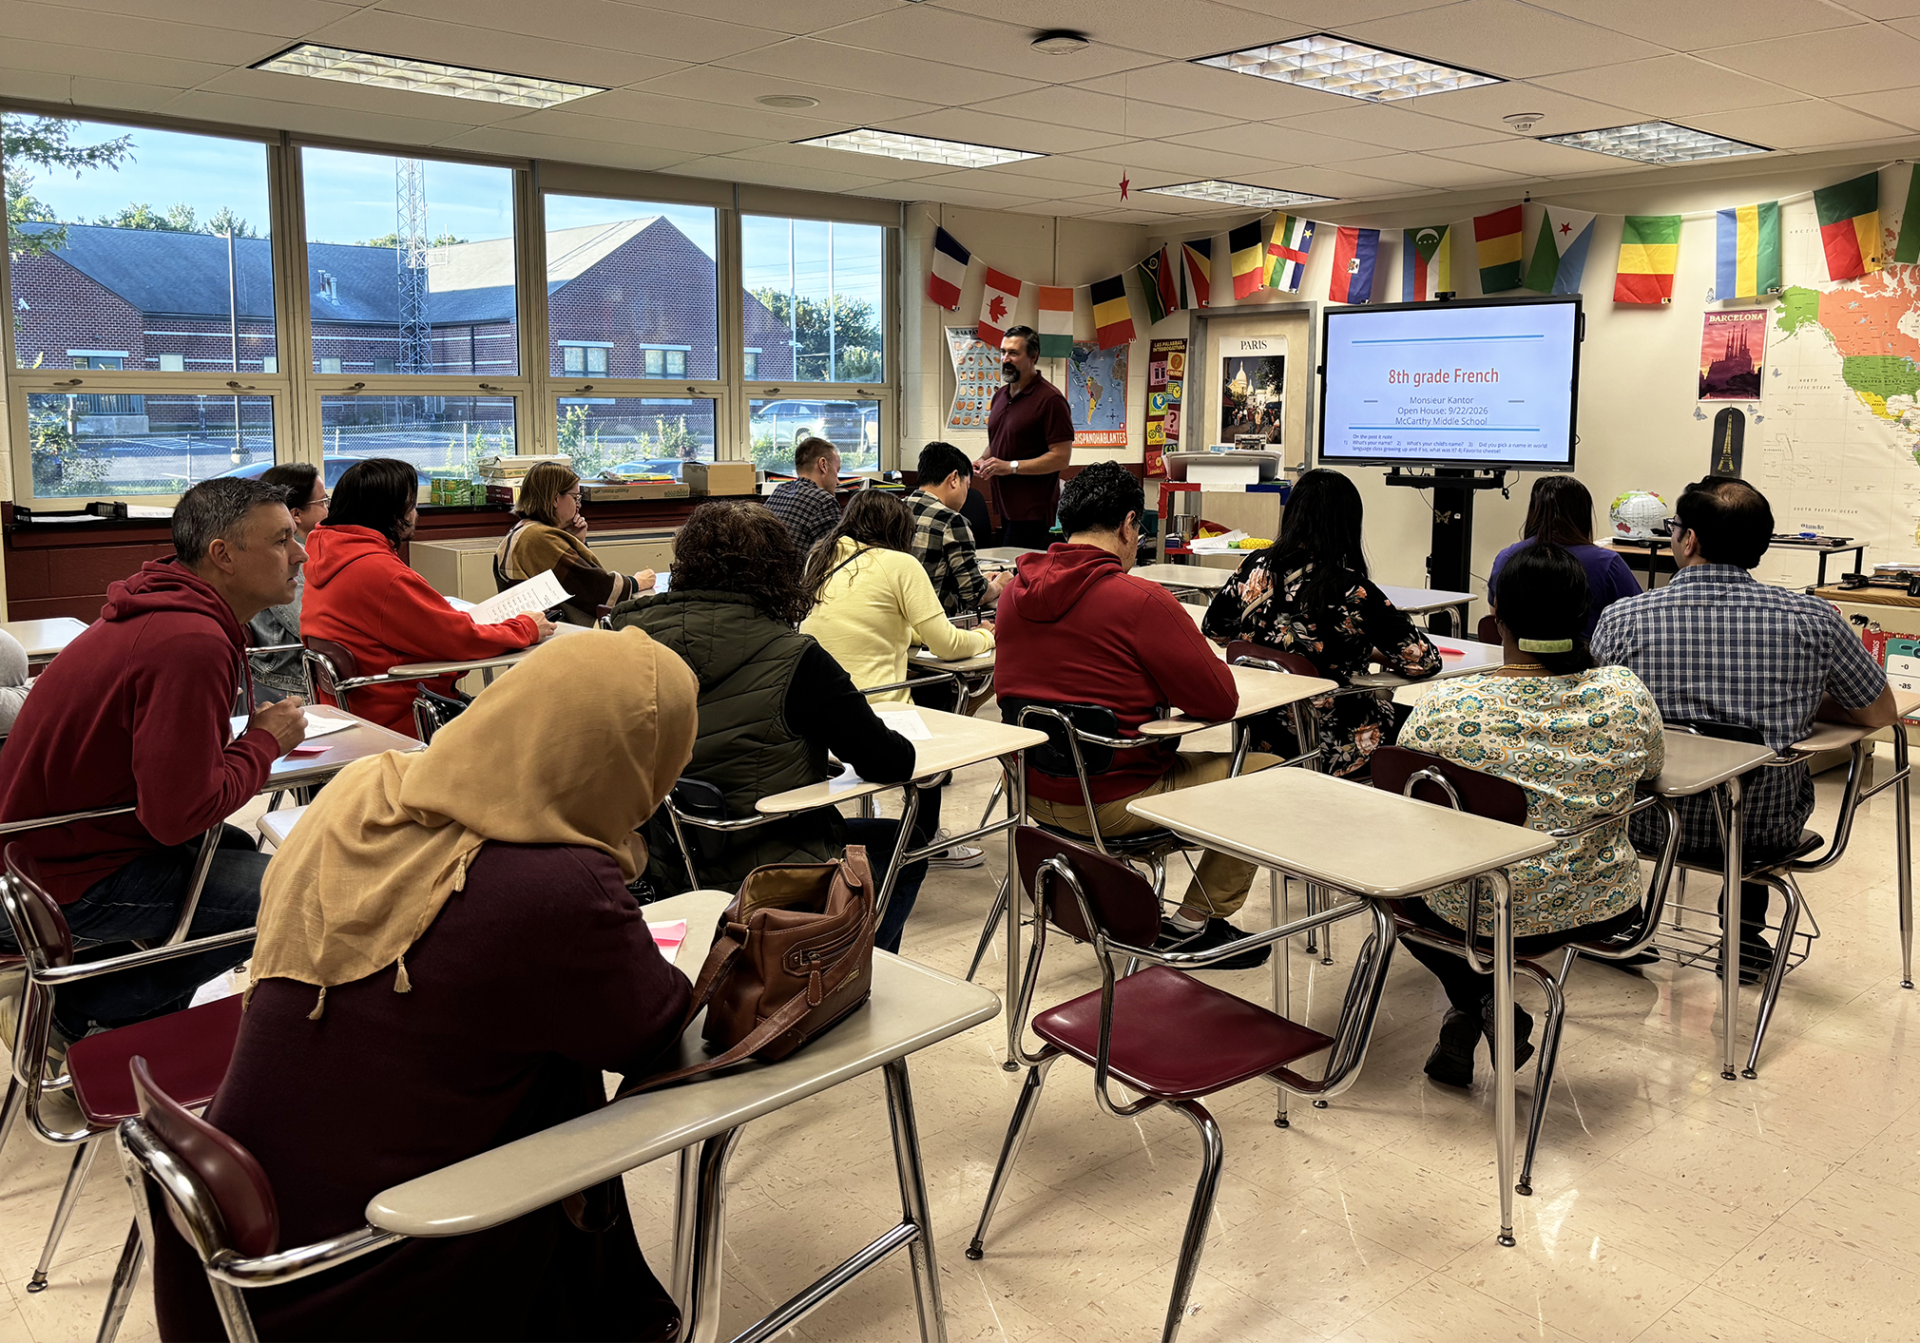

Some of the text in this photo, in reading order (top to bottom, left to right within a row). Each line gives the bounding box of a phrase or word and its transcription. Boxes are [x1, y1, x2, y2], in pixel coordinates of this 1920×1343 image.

[1709, 313, 1763, 322] BARCELONA
[1241, 340, 1267, 350] PARIS
[1388, 367, 1499, 387] 8th grade French
[1409, 396, 1474, 404] Monsieur Kantor
[1397, 406, 1489, 416] Open House: 9/22/2026
[1395, 417, 1488, 427] McCarthy Middle School
